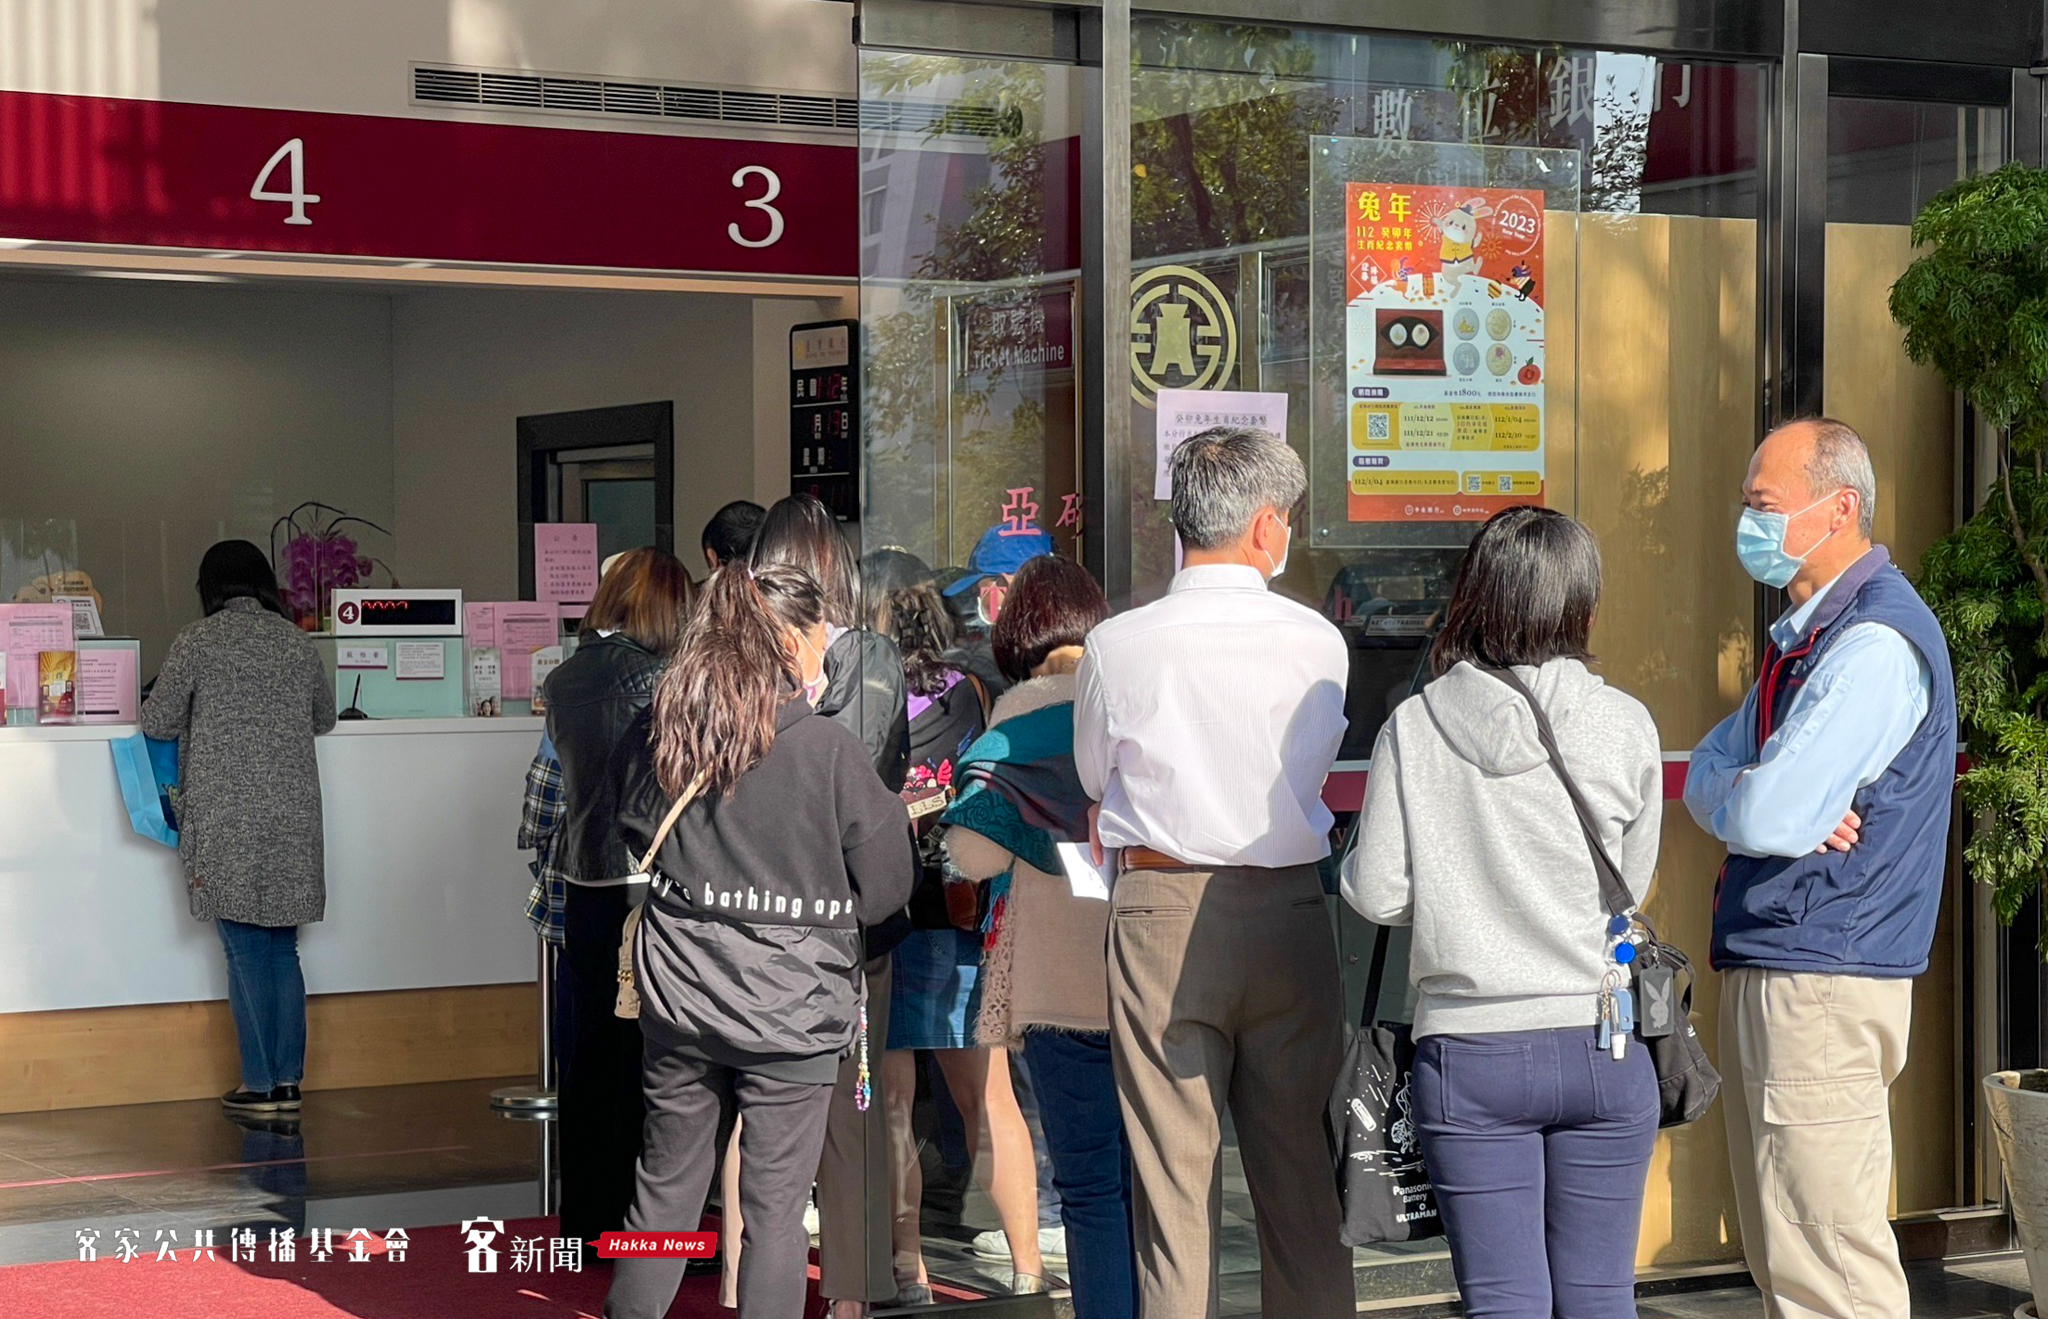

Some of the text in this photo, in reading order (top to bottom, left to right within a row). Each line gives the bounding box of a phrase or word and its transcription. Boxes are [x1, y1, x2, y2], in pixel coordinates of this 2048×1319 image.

[250, 137, 321, 226] 4
[727, 165, 785, 248] 3
[1357, 191, 1412, 223] 兔年
[1355, 226, 1413, 239] 112 癸卯年
[1499, 210, 1536, 234] 2023
[973, 342, 1065, 370] Ticket Machine
[342, 605, 355, 620] 4
[704, 881, 803, 919] bathing
[814, 898, 853, 920] ape
[1402, 1193, 1428, 1204] Battery
[1395, 1208, 1438, 1223] ULTRAMAN
